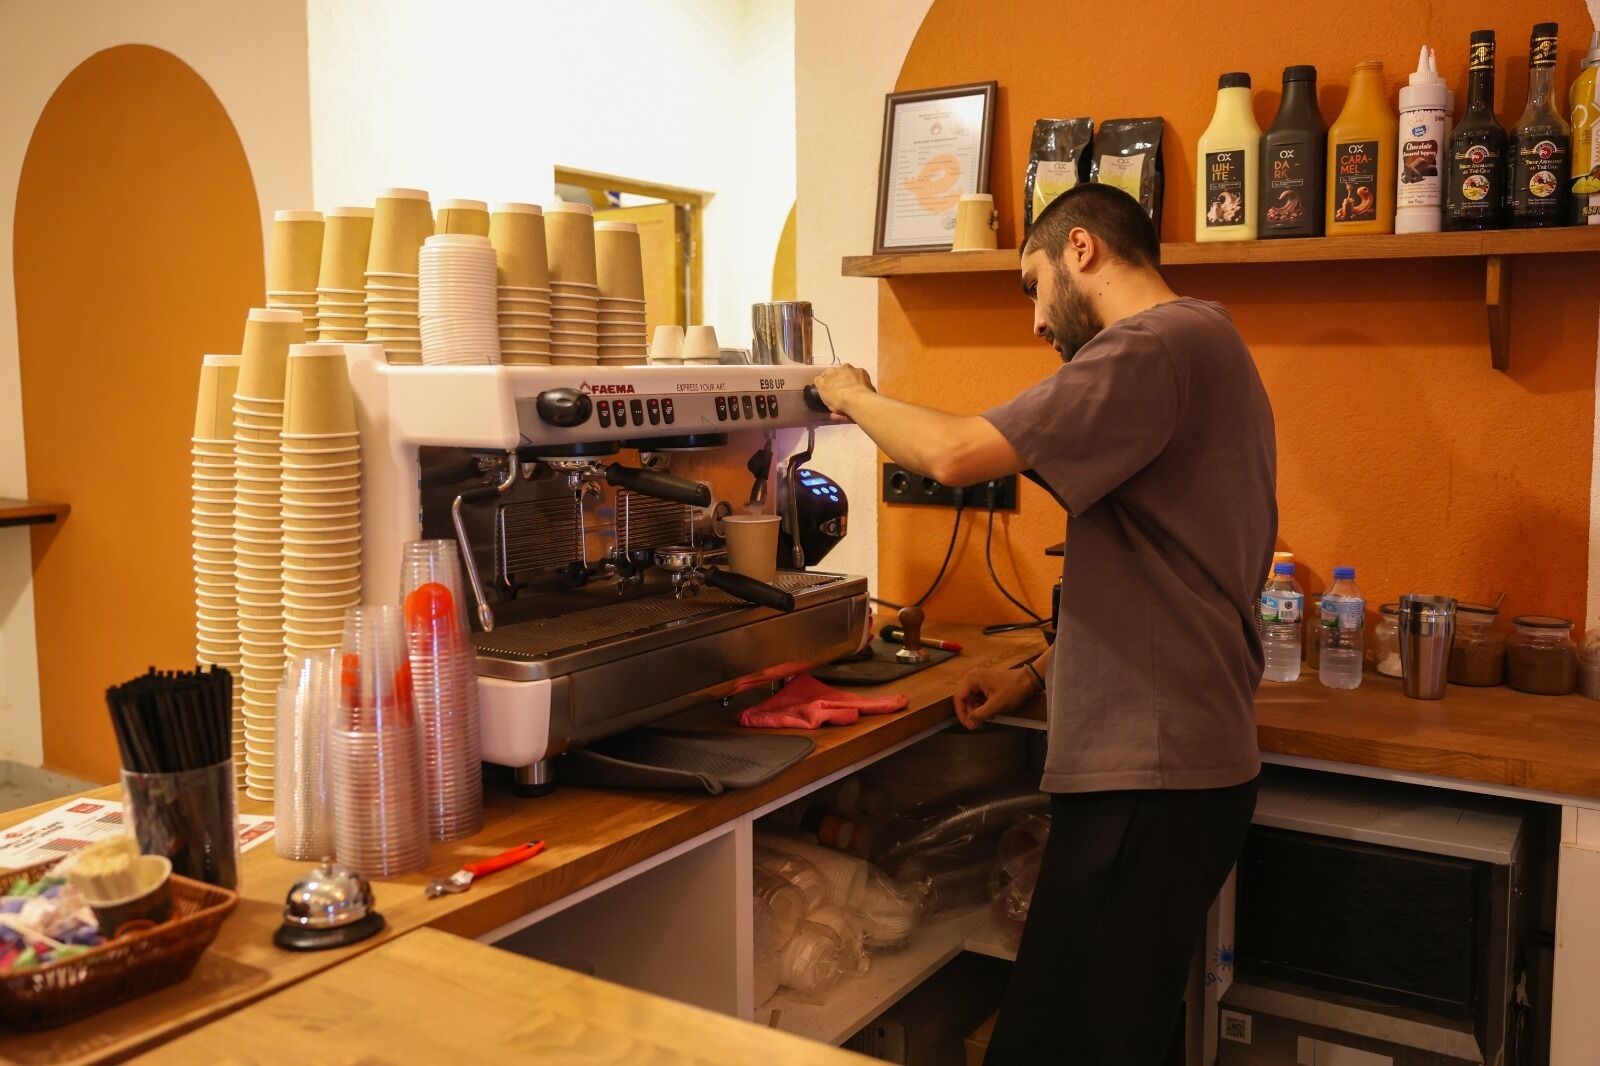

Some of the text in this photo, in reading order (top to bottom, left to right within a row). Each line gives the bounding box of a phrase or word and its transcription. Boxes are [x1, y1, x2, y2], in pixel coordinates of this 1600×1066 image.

[1279, 149, 1295, 159] OX
[1348, 144, 1364, 154] OX
[1217, 152, 1232, 162] OX
[1274, 169, 1288, 179] RK
[1340, 164, 1360, 174] MEL
[1212, 171, 1229, 181] ITE
[591, 384, 636, 394] FAEMA
[676, 383, 699, 392] EXPRESS
[699, 383, 715, 391] YOUR
[760, 378, 785, 390] E98 UP
